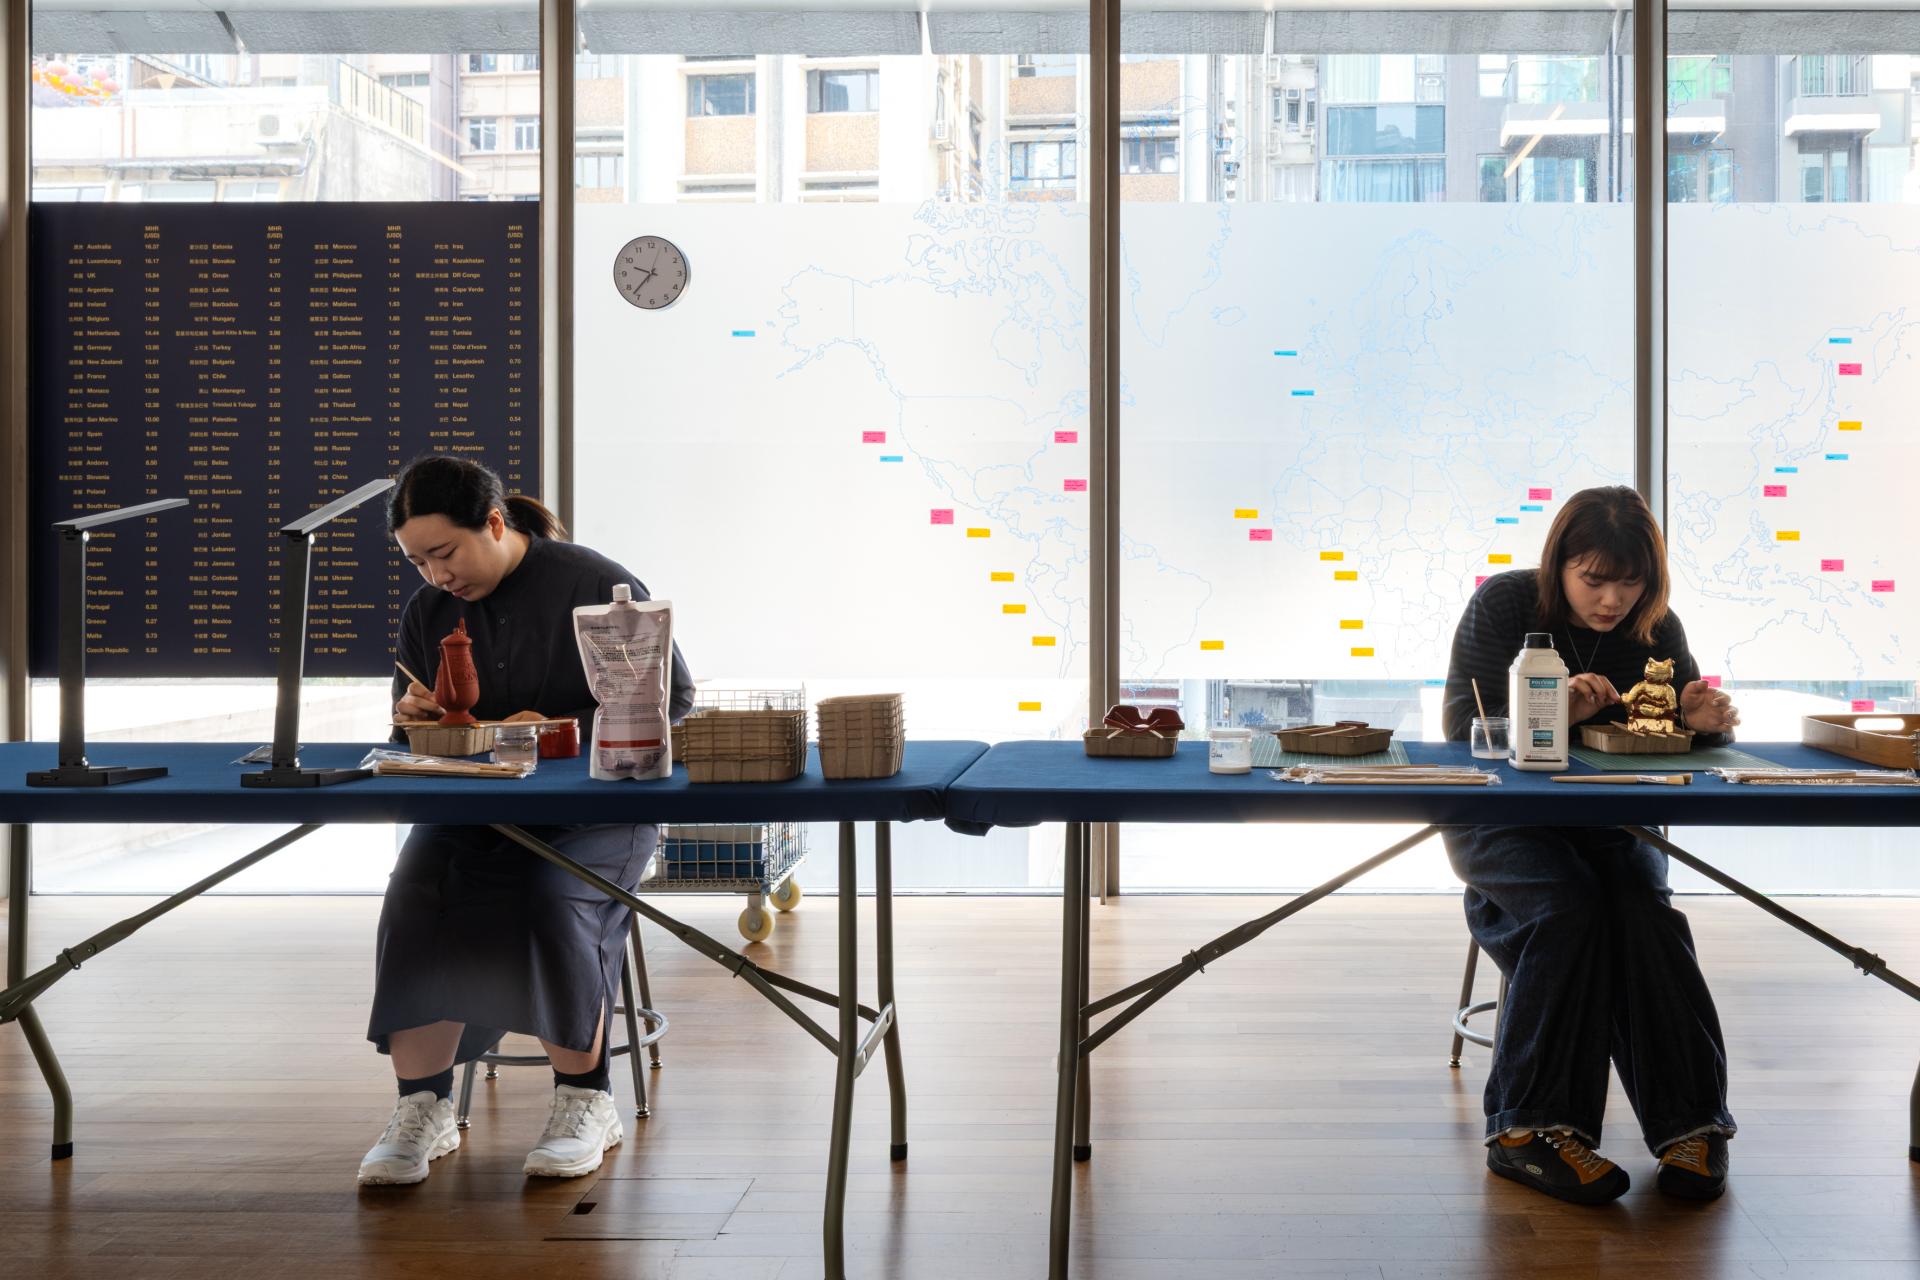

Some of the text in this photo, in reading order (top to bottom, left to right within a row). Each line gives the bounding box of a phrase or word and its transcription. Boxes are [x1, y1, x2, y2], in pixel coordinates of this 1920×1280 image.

[333, 272, 362, 280] Philippines
[462, 272, 480, 280] Congo
[332, 286, 356, 294] Malaysia
[453, 286, 467, 294] Cape
[453, 315, 471, 323] Algeria
[87, 344, 112, 352] Germany
[212, 344, 231, 352] Turkey
[87, 431, 103, 439] Spain
[453, 445, 484, 453] Afghanistan
[87, 604, 110, 612] Portugal
[332, 618, 351, 626] Nigeria
[105, 647, 129, 655] Republic
[332, 647, 347, 655] Niger
